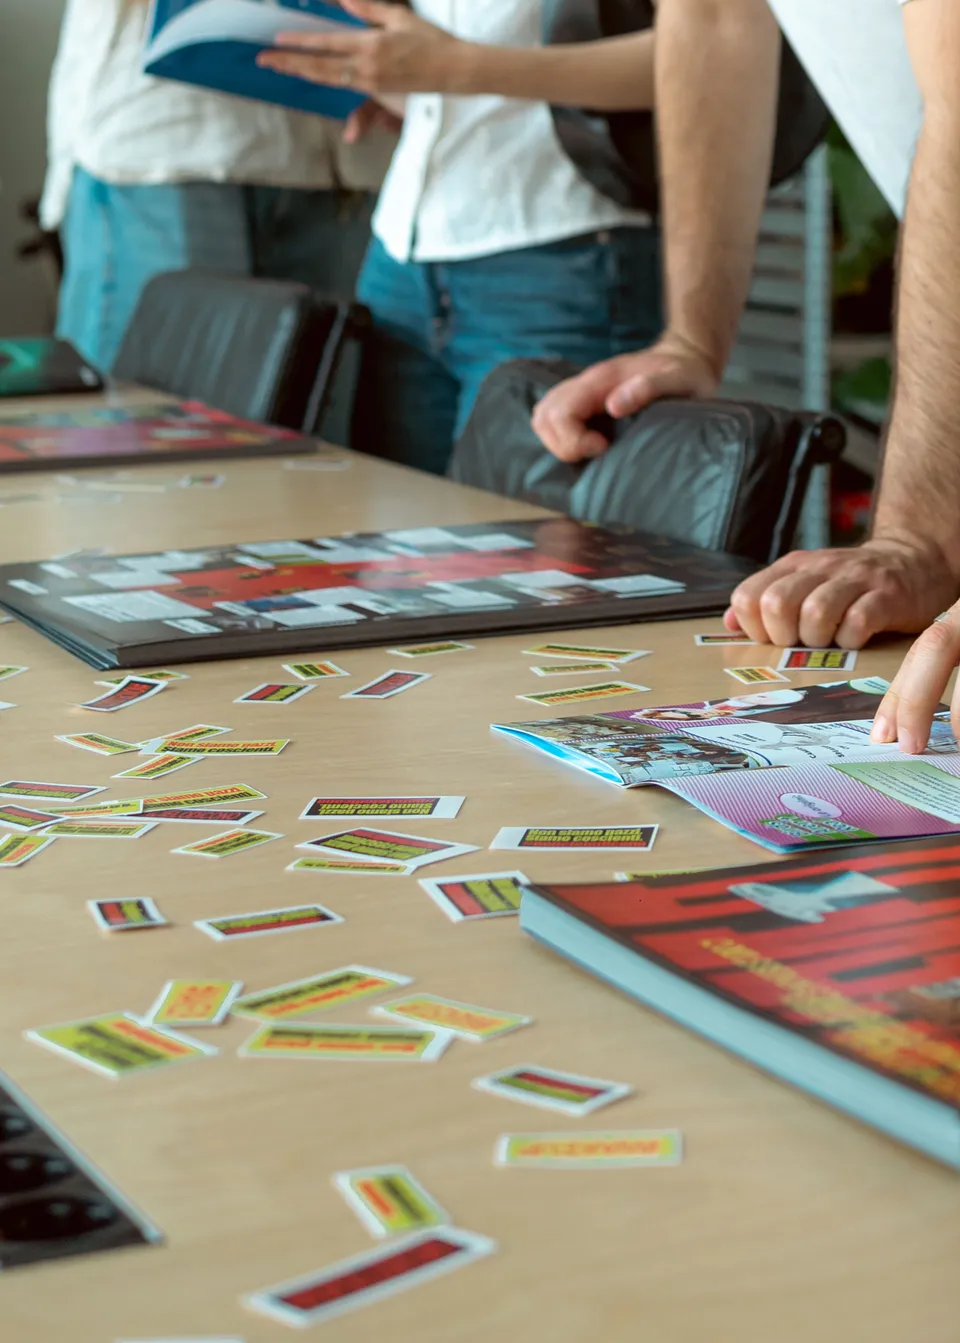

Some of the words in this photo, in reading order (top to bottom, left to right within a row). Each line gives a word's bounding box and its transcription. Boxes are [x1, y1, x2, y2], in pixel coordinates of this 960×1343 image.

[528, 828, 556, 836] Non
[558, 828, 602, 836] siamo
[525, 834, 570, 842] Siamo
